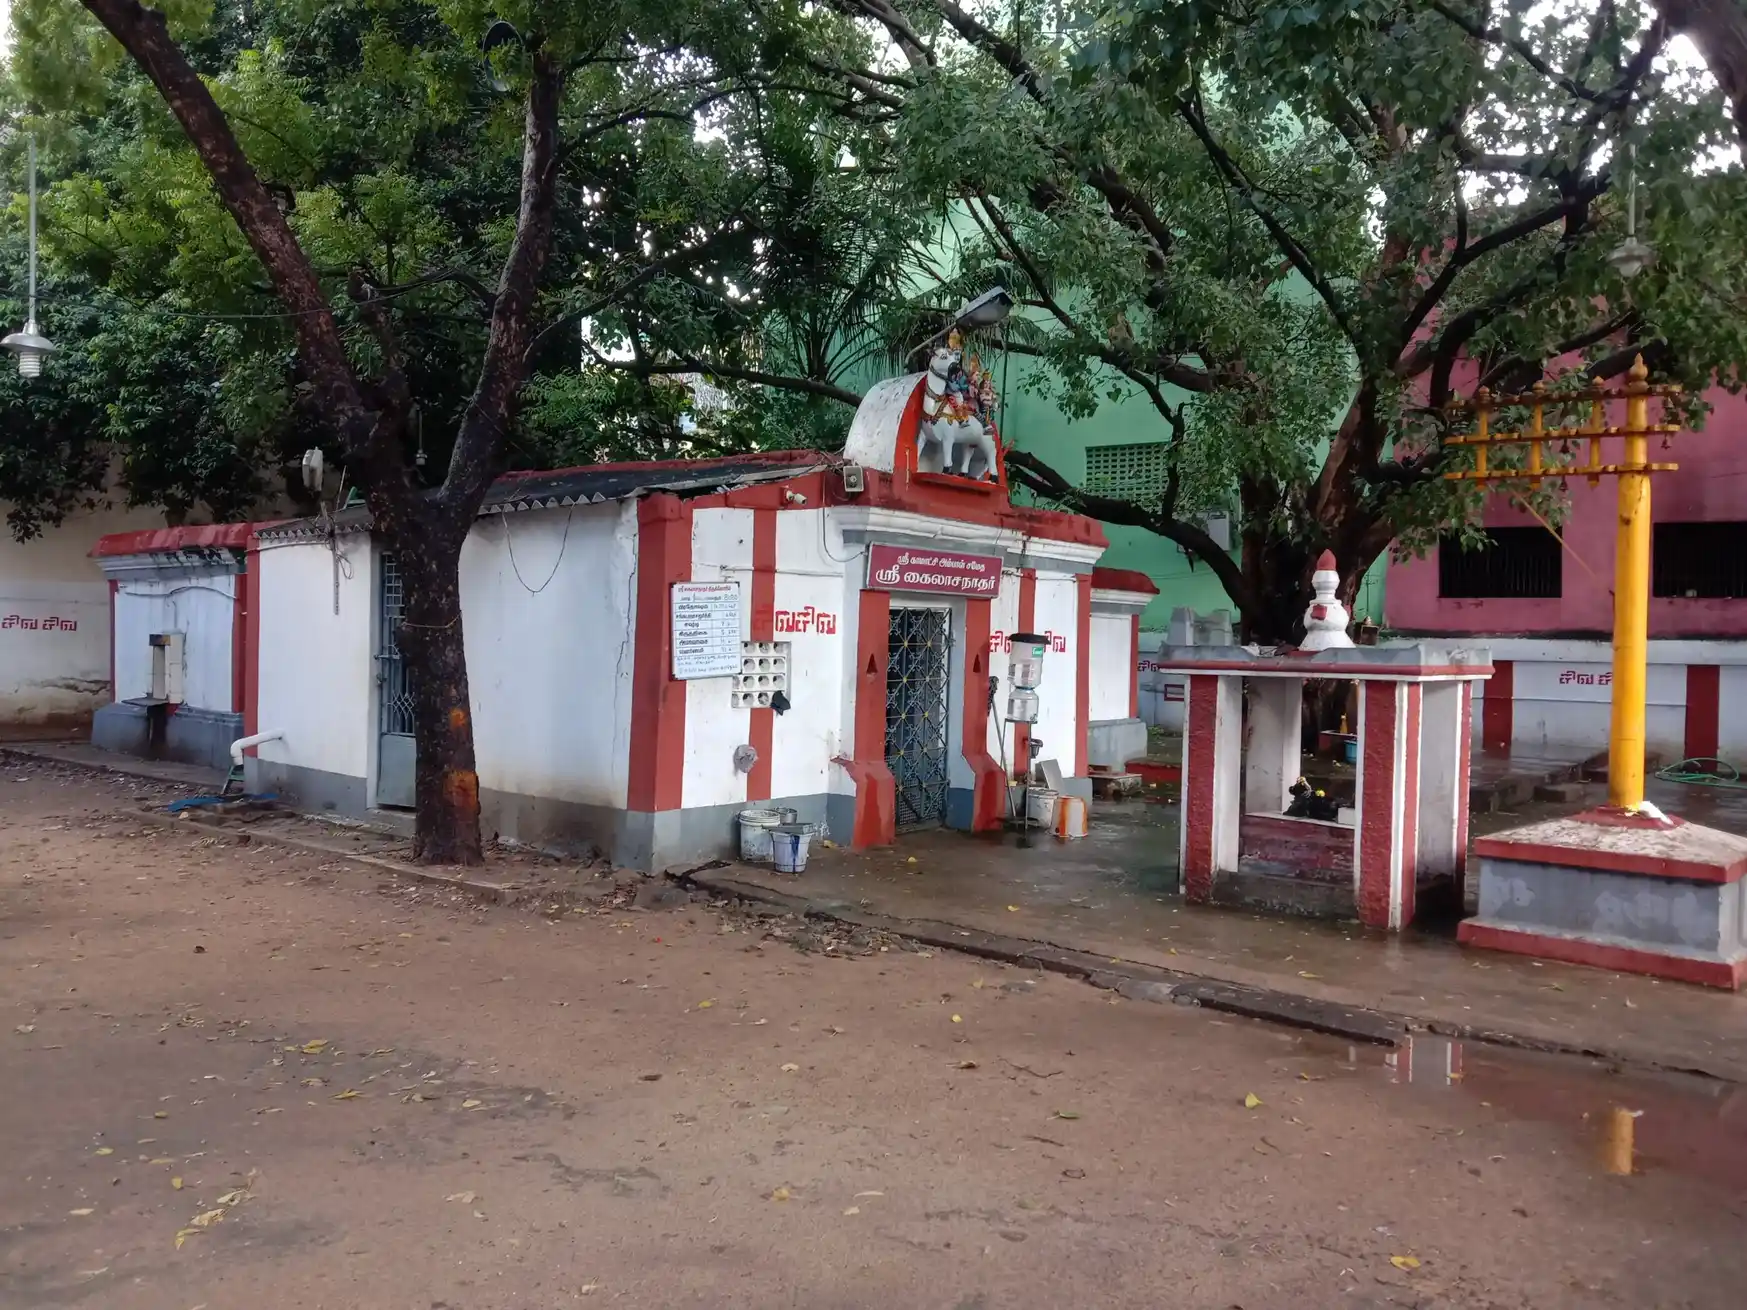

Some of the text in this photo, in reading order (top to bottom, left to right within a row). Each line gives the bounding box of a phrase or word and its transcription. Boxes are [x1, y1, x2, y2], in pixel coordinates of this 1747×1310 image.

[897, 551, 909, 566] ஸ்ரீ
[910, 555, 938, 567] காமாட்சி
[939, 558, 966, 569] அம்பாள்
[875, 564, 996, 592] ஸ்ரீ கைலாசநாதர்
[1, 614, 78, 632] சிவ சிவ
[1559, 670, 1594, 685] சிவ
